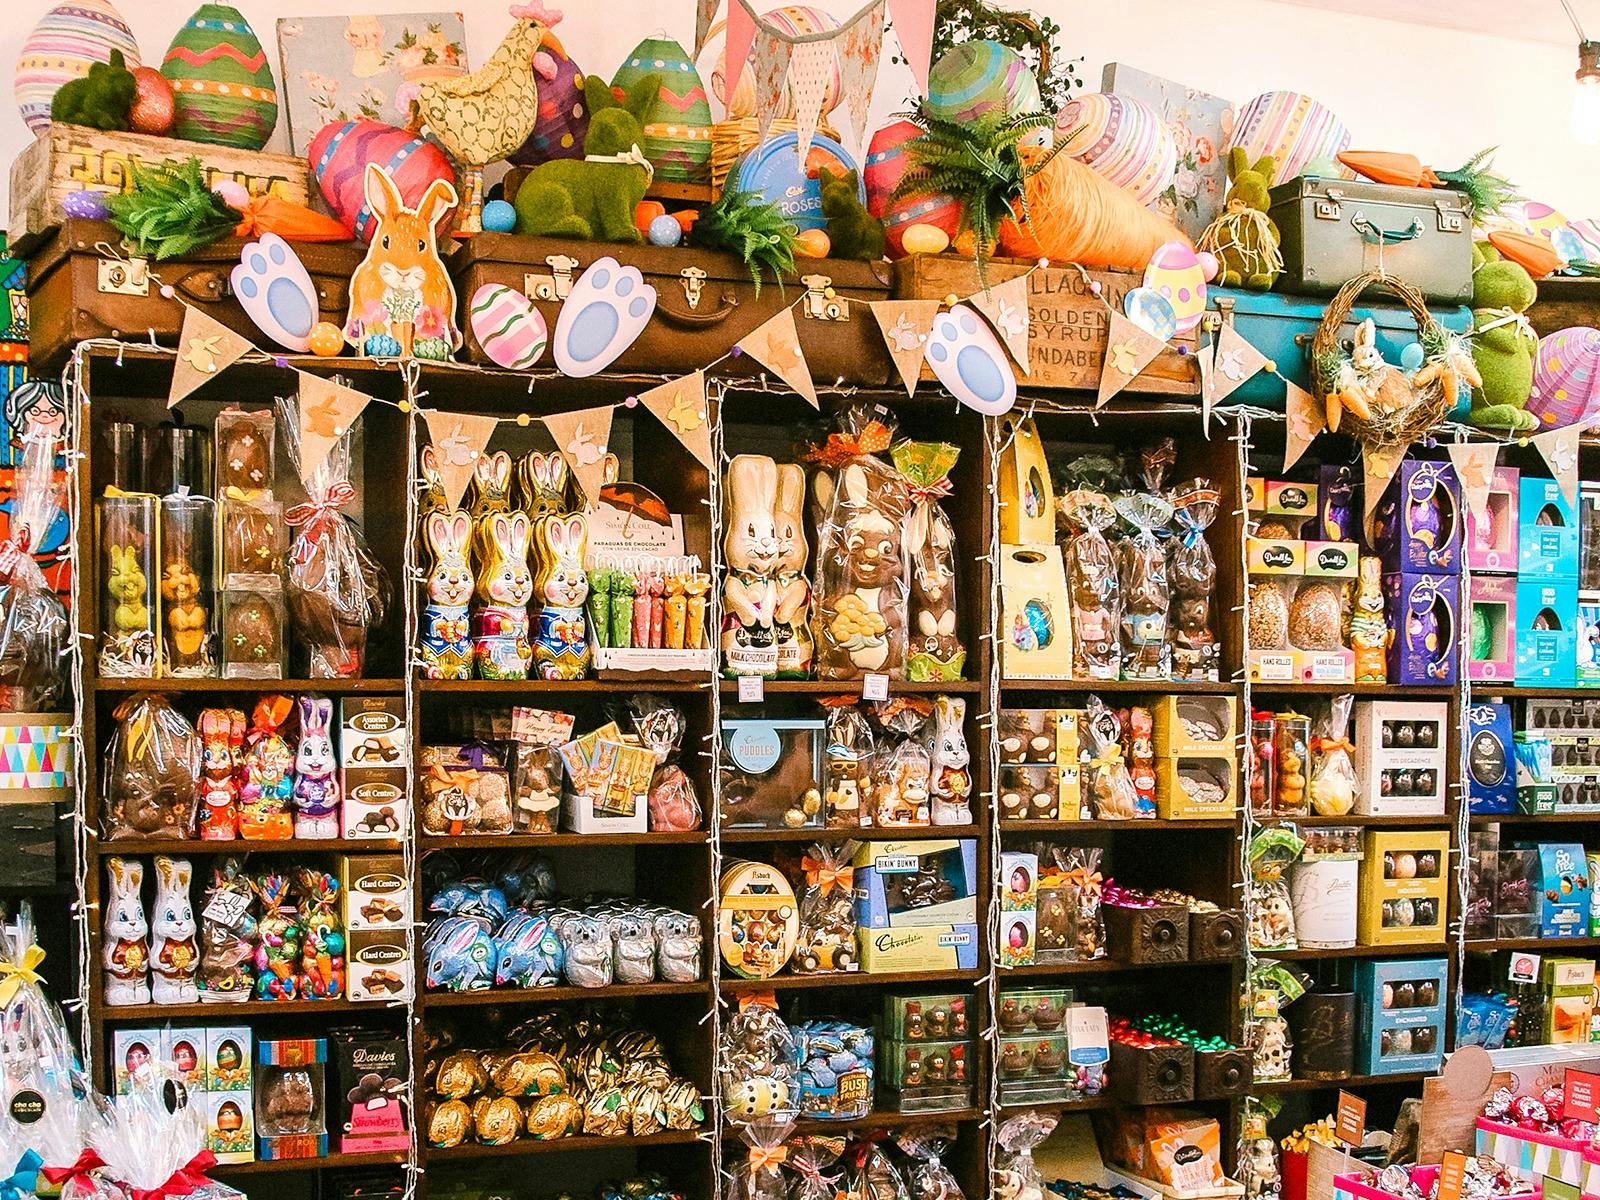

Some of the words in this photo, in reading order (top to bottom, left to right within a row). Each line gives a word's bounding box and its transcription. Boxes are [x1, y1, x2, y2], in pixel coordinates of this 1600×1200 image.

[782, 197, 822, 215] ROSES
[1029, 323, 1107, 342] SYRUP
[731, 652, 745, 662] MILK
[362, 715, 388, 723] Assorted
[739, 745, 775, 756] PUDDLES
[358, 789, 371, 797] Soft
[372, 789, 395, 797] Centres
[1537, 800, 1553, 811] free
[1555, 849, 1571, 862] So
[897, 859, 917, 867] BUNNY
[1555, 860, 1575, 875] free
[361, 880, 377, 888] Hard
[378, 880, 400, 888] Centres
[363, 951, 378, 960] Hard
[379, 951, 401, 959] Centres
[353, 1048, 396, 1063] Davies
[841, 1079, 867, 1093] BUSH
[840, 1090, 867, 1101] FRIENDS
[1571, 1100, 1591, 1108] CHERRY
[353, 1116, 399, 1127] Strawberry
